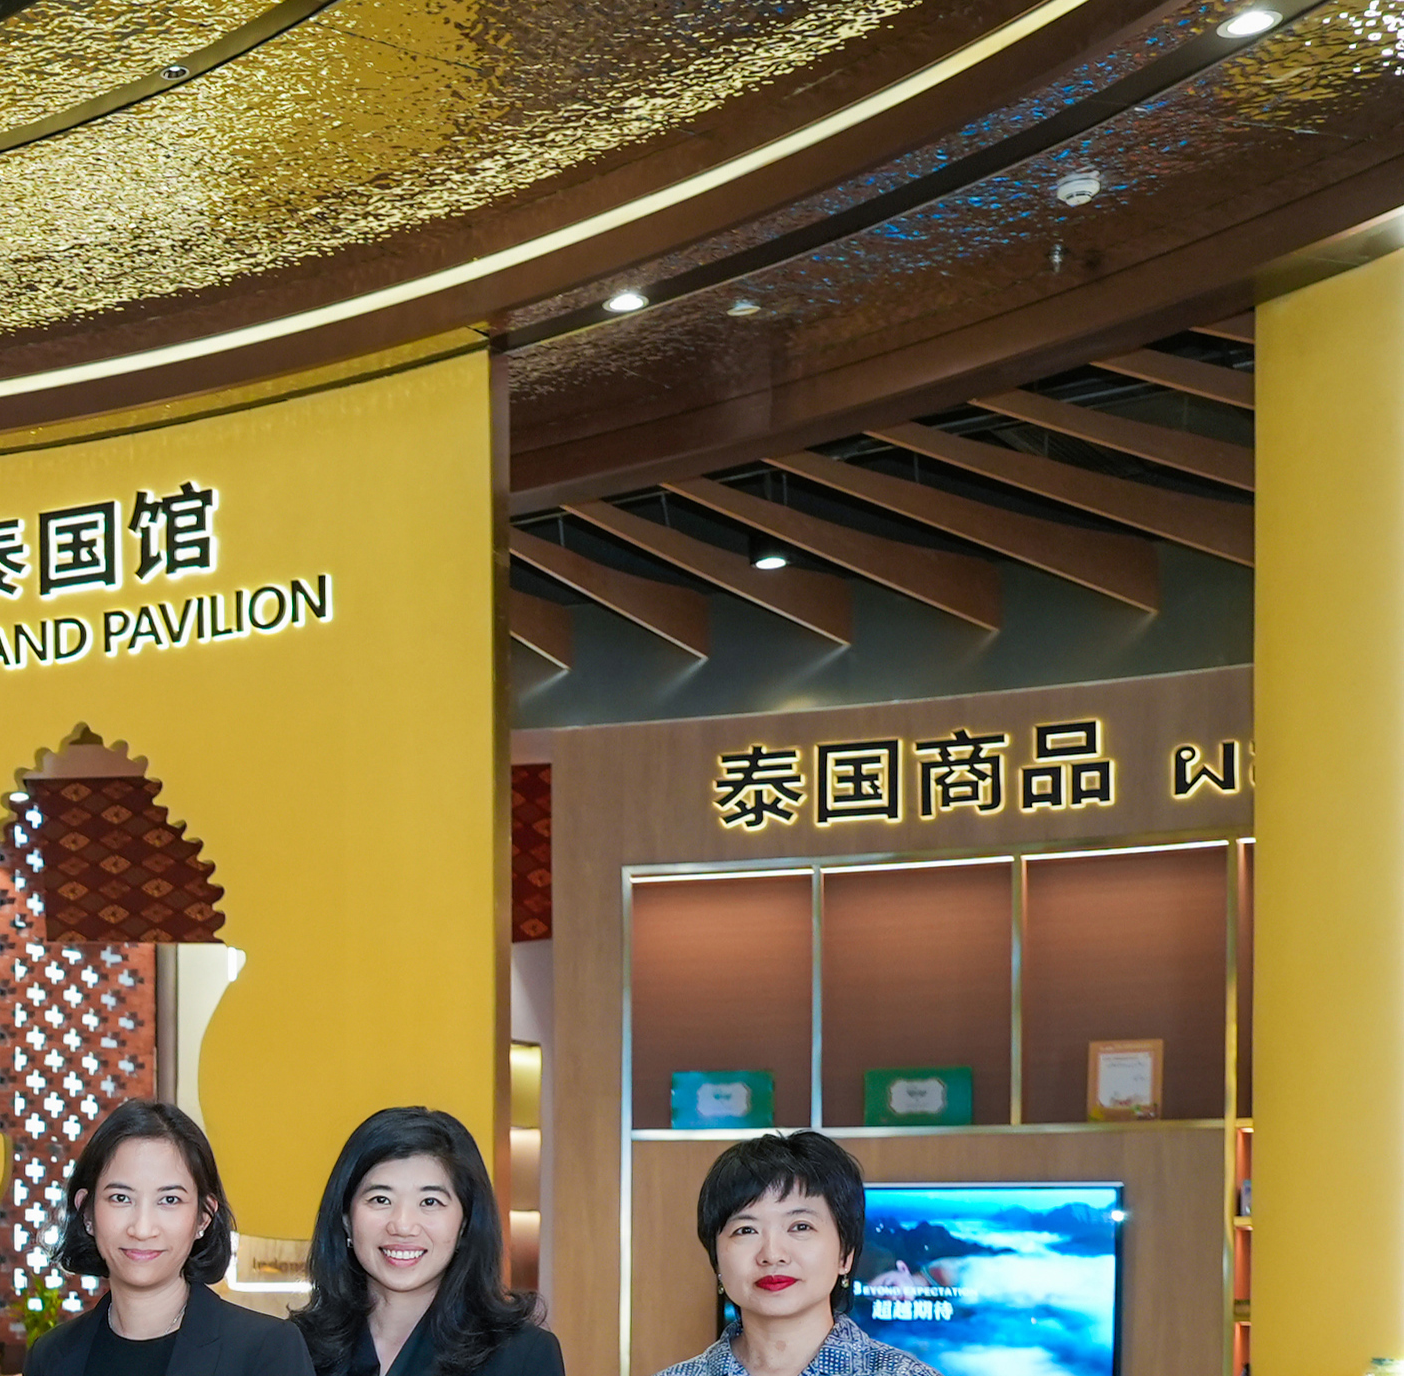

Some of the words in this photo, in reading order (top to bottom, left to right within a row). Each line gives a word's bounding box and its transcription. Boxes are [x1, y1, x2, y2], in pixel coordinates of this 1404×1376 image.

[102, 574, 330, 655] PAVILION
[713, 718, 1114, 830] 泰国商品
[1173, 743, 1254, 796] ผ
